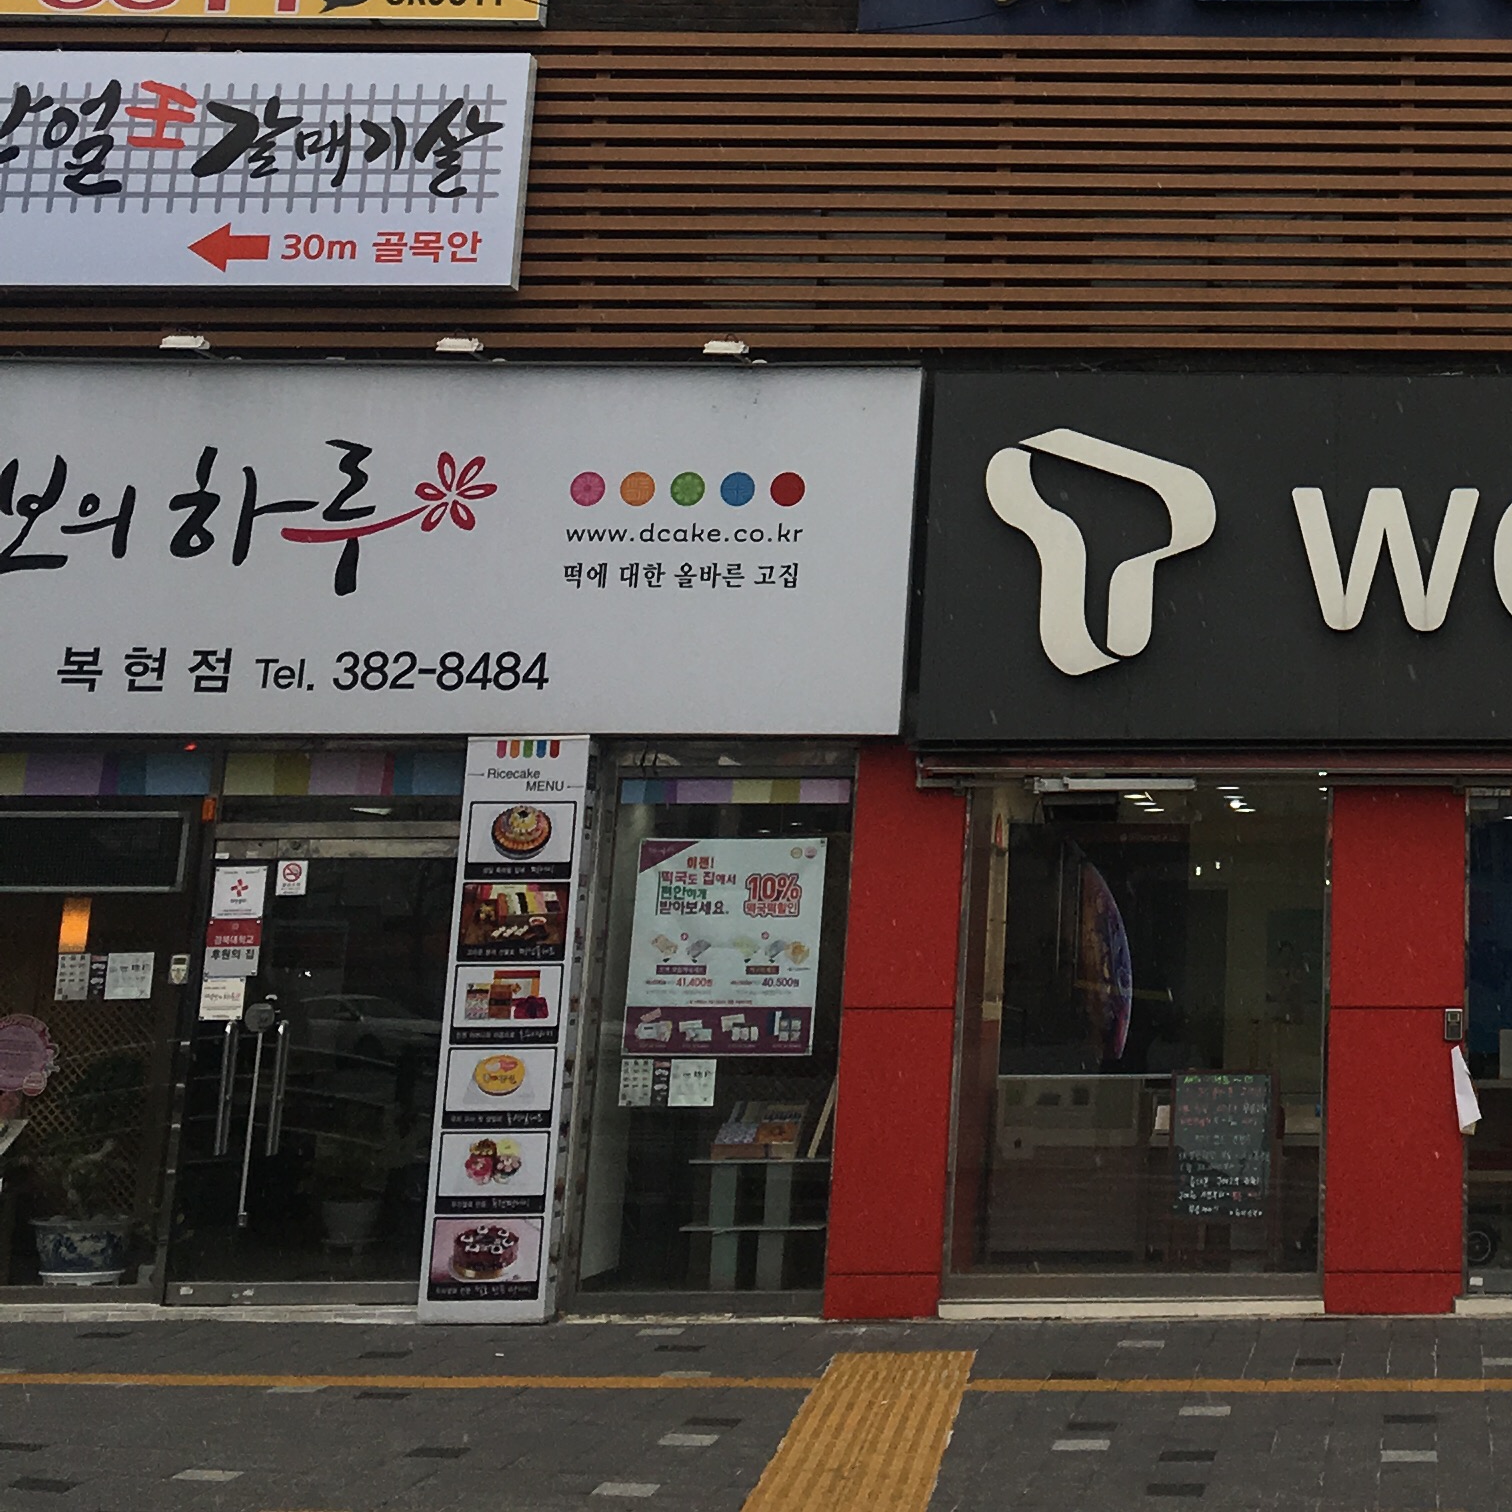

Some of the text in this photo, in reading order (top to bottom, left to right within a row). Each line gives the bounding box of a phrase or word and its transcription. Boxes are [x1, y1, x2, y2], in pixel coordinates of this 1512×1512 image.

[280, 231, 484, 264] 30m 골목안
[565, 524, 804, 545] www.dcake.co.kr
[562, 562, 801, 590] 떡에 대한 올바른 고집
[57, 646, 550, 694] 복현점 Tel. 382-8484
[486, 767, 541, 780] Ricecake
[525, 780, 565, 793] MENU
[746, 873, 801, 901] 10%
[213, 934, 255, 946] 경북대학교
[210, 948, 255, 961] 후원의 집
